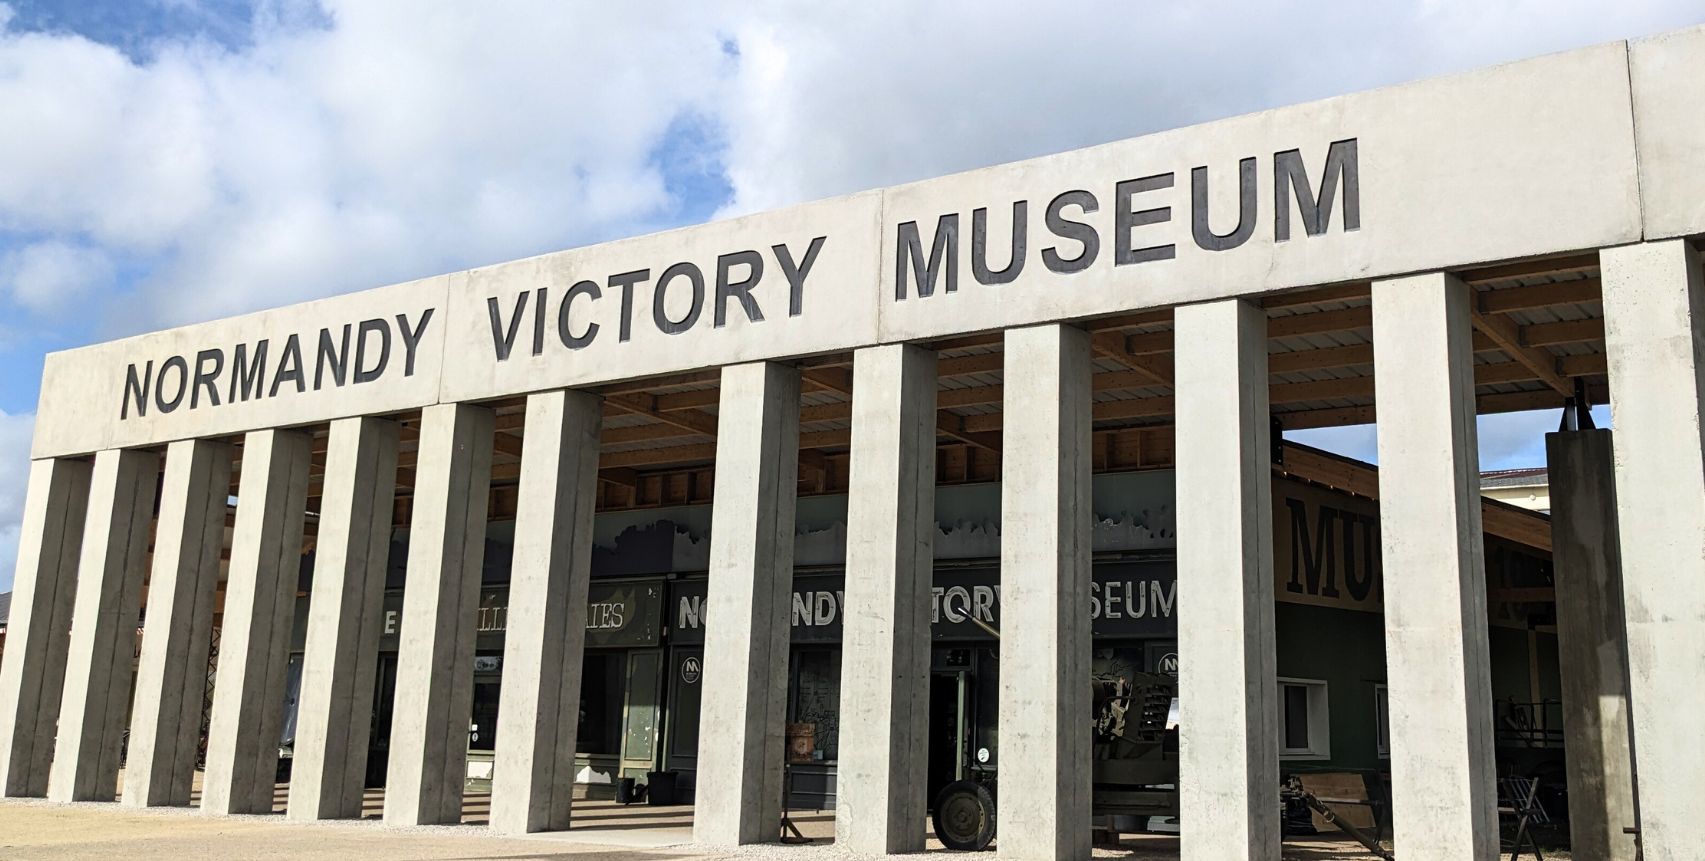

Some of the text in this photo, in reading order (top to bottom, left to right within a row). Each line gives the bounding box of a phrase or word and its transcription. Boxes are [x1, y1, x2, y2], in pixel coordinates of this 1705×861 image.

[121, 137, 1361, 420] NORMANDY VICTORY MUSEUM
[586, 602, 625, 628] IES
